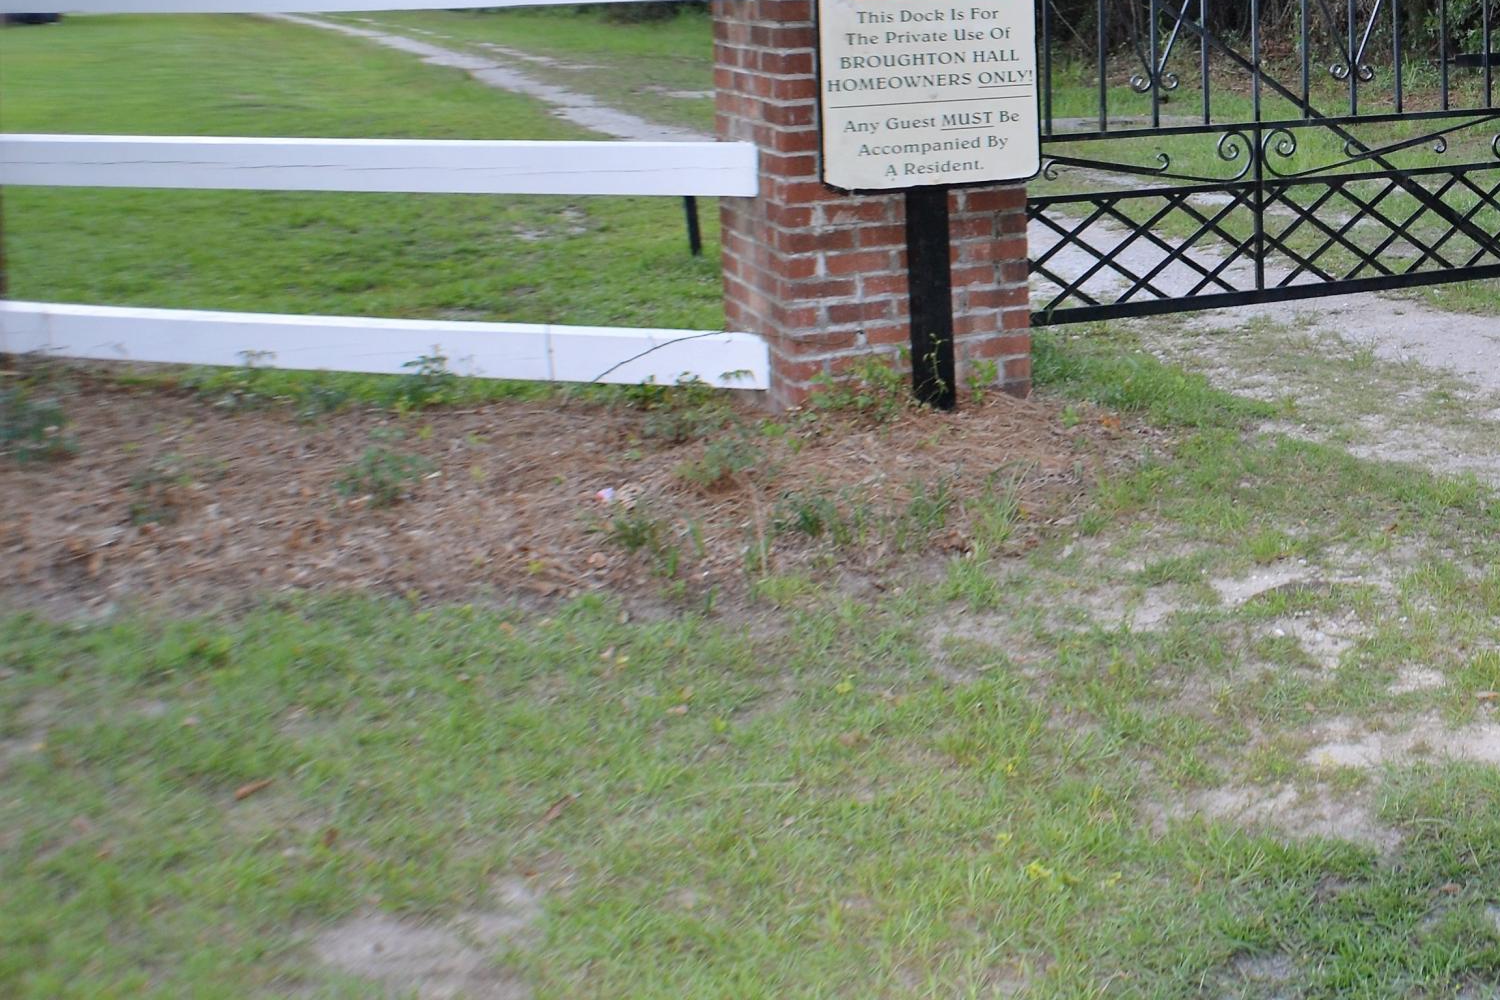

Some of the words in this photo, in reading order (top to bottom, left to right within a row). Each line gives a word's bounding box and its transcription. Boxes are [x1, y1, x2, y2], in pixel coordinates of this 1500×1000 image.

[857, 11, 894, 24] This
[900, 9, 945, 23] Dock
[951, 8, 965, 21] Is
[970, 7, 999, 20] For
[846, 32, 879, 46] The
[885, 30, 948, 44] Private
[954, 29, 984, 41] Use
[990, 27, 1011, 40] Of
[840, 51, 966, 69] BROUGHTON
[973, 49, 1020, 63] HALL
[827, 73, 972, 92] HOMEOWNERS
[978, 70, 1033, 84] ONLY!
[843, 120, 880, 134] Any
[886, 117, 936, 130] Guest
[941, 111, 993, 127] MUST
[999, 110, 1020, 123] Be
[857, 136, 981, 157] Accompanied
[987, 135, 1009, 150] By
[885, 164, 898, 177] A
[904, 160, 984, 176] Resident.
